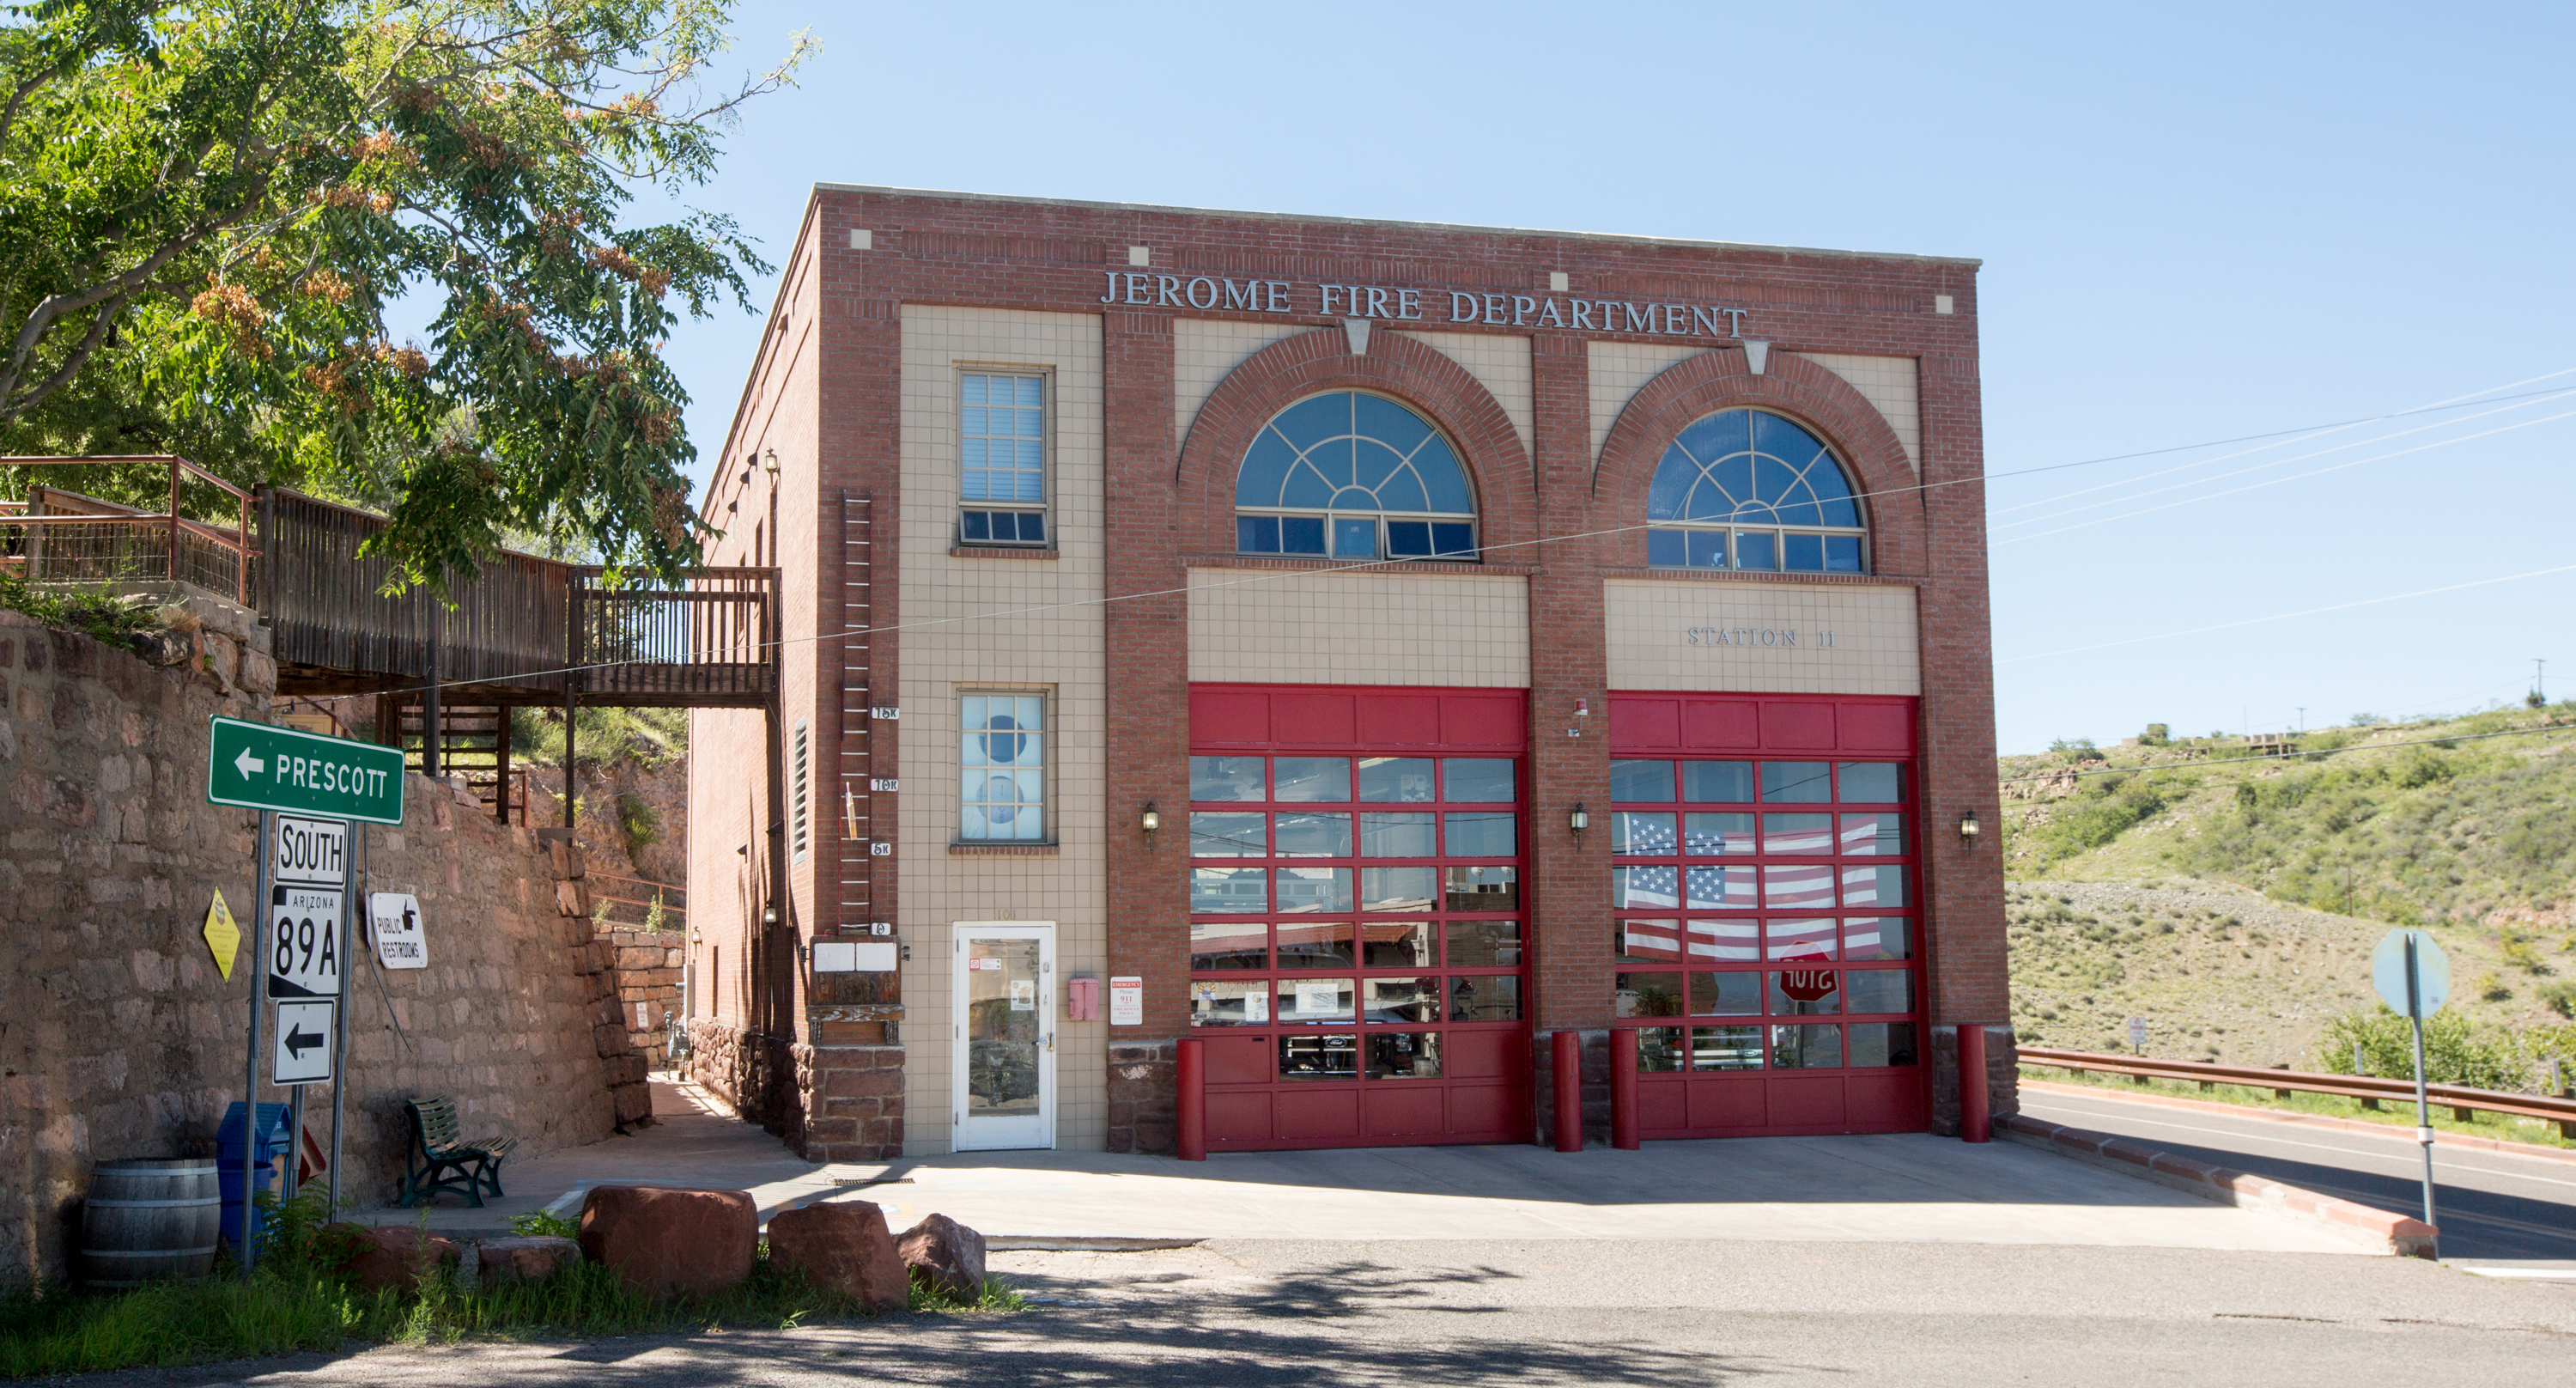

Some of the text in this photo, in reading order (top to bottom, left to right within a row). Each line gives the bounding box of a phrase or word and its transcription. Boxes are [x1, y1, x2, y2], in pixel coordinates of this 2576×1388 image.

[1100, 271, 1747, 338] JEROME FIRE DEPARTMENT
[1688, 627, 1836, 647] STATION 11
[875, 708, 897, 718] 15K
[276, 753, 387, 799] PRESCOTT
[874, 779, 897, 790] 10K
[281, 824, 343, 872] SOUTH
[874, 843, 889, 855] 5K
[293, 895, 335, 910] ARIZONA
[998, 910, 1016, 921] 101
[377, 916, 402, 934] PUBLIC
[276, 916, 337, 977] 89A
[381, 941, 420, 959] RESTROOMS
